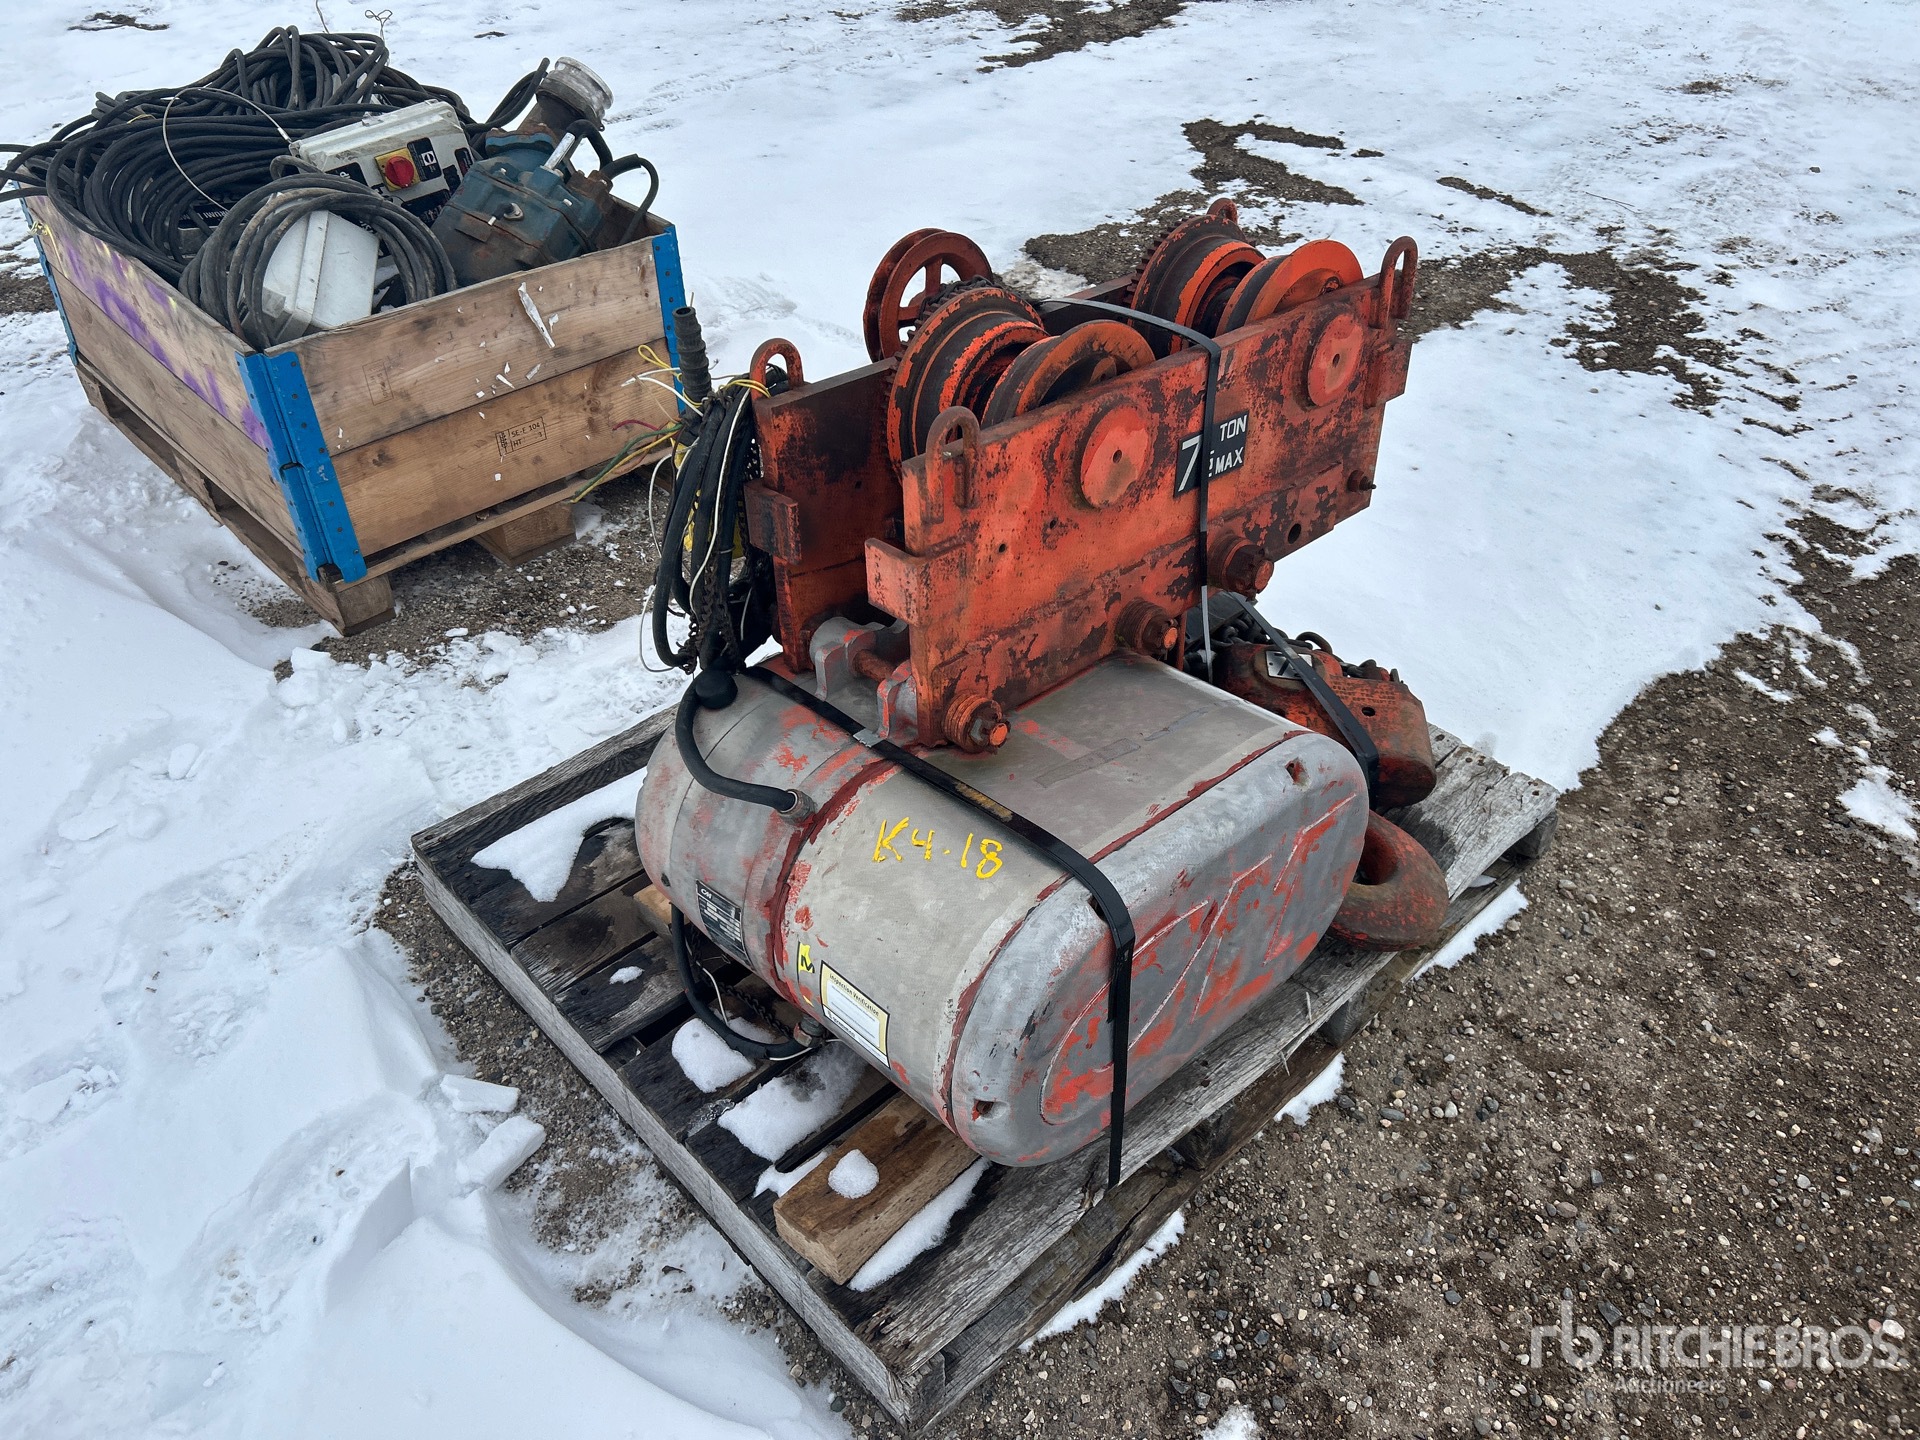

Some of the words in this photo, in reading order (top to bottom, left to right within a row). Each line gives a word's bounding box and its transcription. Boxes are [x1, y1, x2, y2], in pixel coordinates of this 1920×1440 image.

[1220, 414, 1247, 442] TON
[1215, 446, 1243, 475] MAX
[829, 973, 853, 996] Inspection
[853, 991, 880, 1017] Verification
